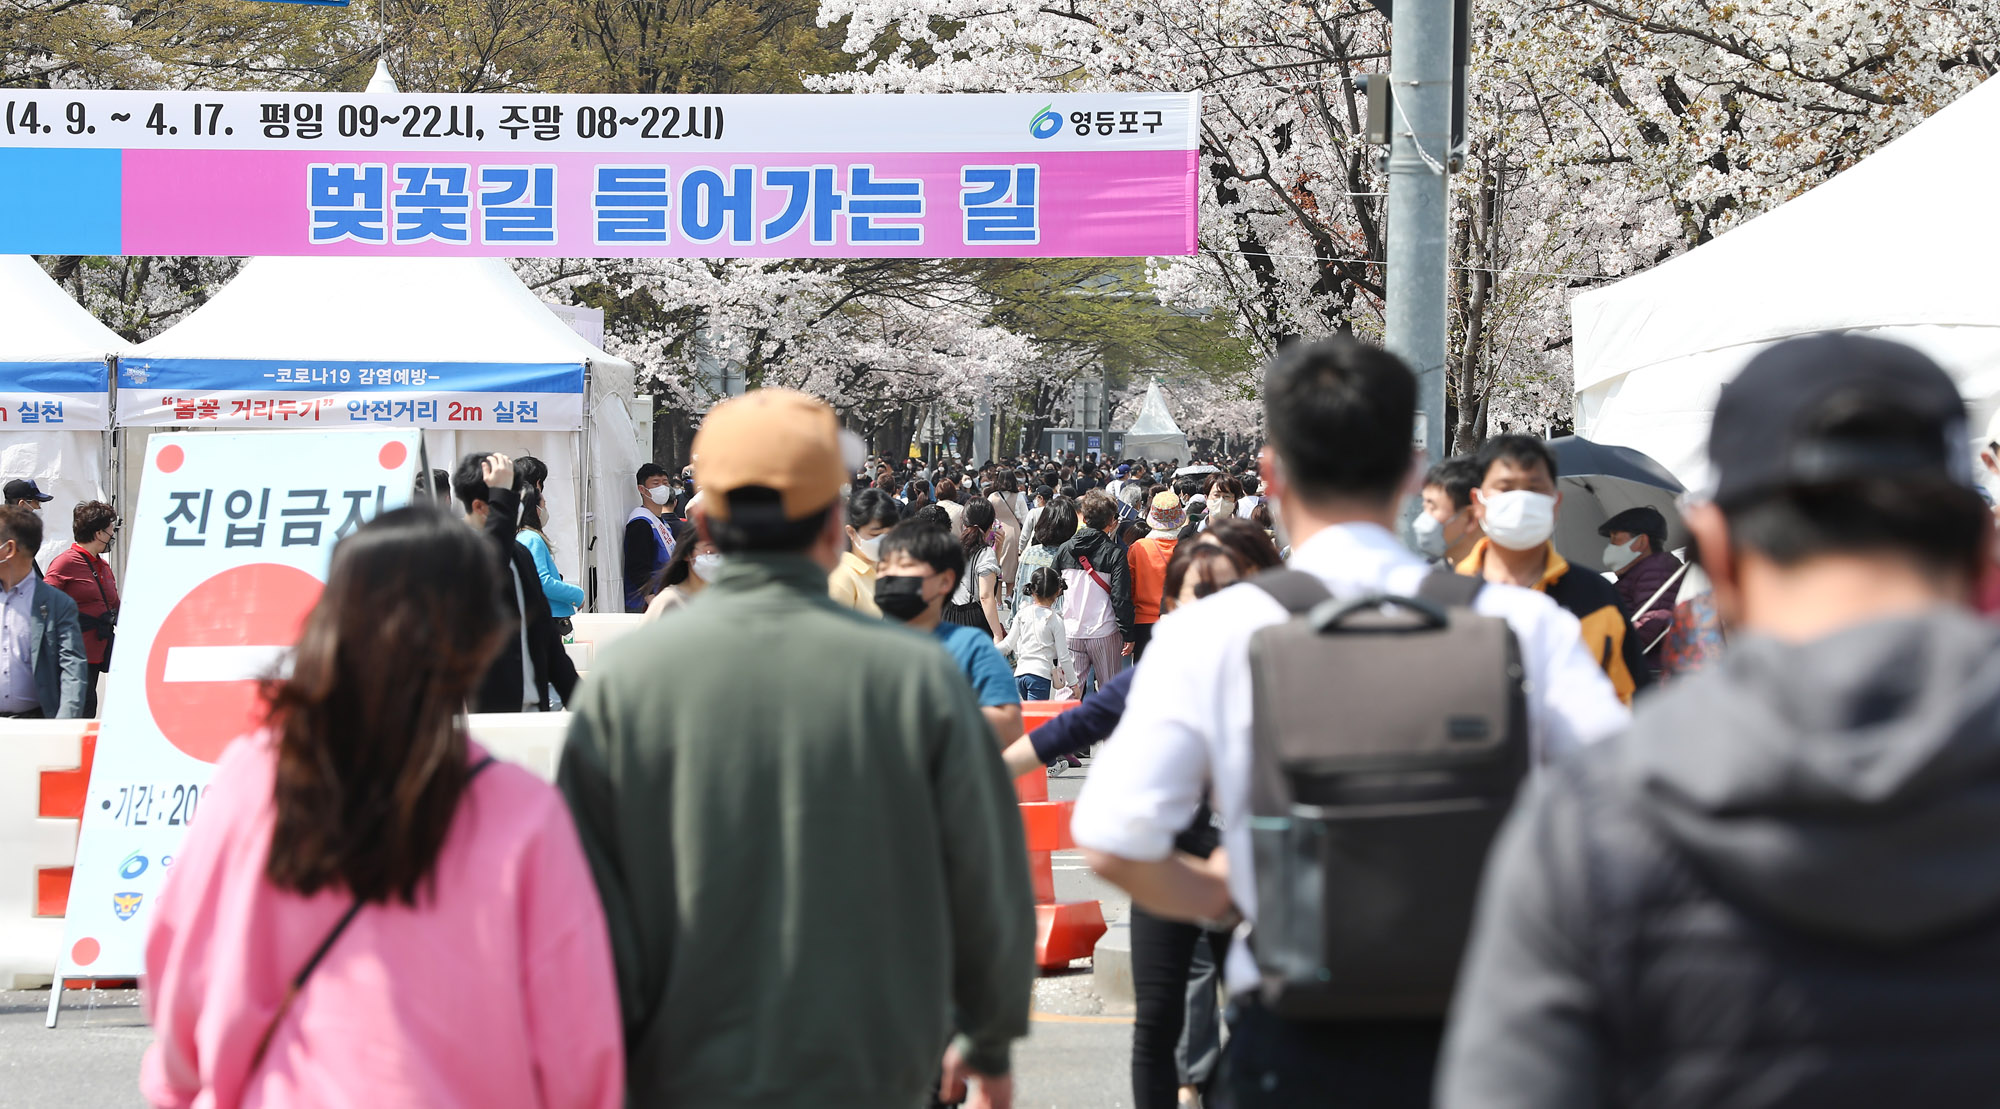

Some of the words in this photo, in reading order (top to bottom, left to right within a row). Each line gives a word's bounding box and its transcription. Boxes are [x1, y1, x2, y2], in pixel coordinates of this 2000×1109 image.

[6, 101, 51, 134] (4.
[66, 101, 96, 134] 9.
[146, 102, 178, 135] 4.
[194, 103, 234, 136] 17.
[260, 103, 323, 139] 평일
[338, 104, 484, 141] 09~22시,
[499, 104, 564, 141] 주말
[576, 104, 724, 140] 08~22시)
[1070, 111, 1163, 136] 영등포구
[307, 163, 558, 245] 벚꽃길
[591, 164, 925, 246] 들어가는
[960, 164, 1041, 246] 길
[263, 368, 351, 385] -코로나19
[358, 368, 440, 386] 감염예방-
[17, 400, 64, 424] 실천
[161, 396, 221, 420] “봄꽃
[231, 398, 335, 421] 거리두기”
[346, 399, 438, 422] 안전거리
[447, 401, 482, 422] 2m
[492, 401, 538, 423] 실천
[163, 485, 387, 549] 진입금지
